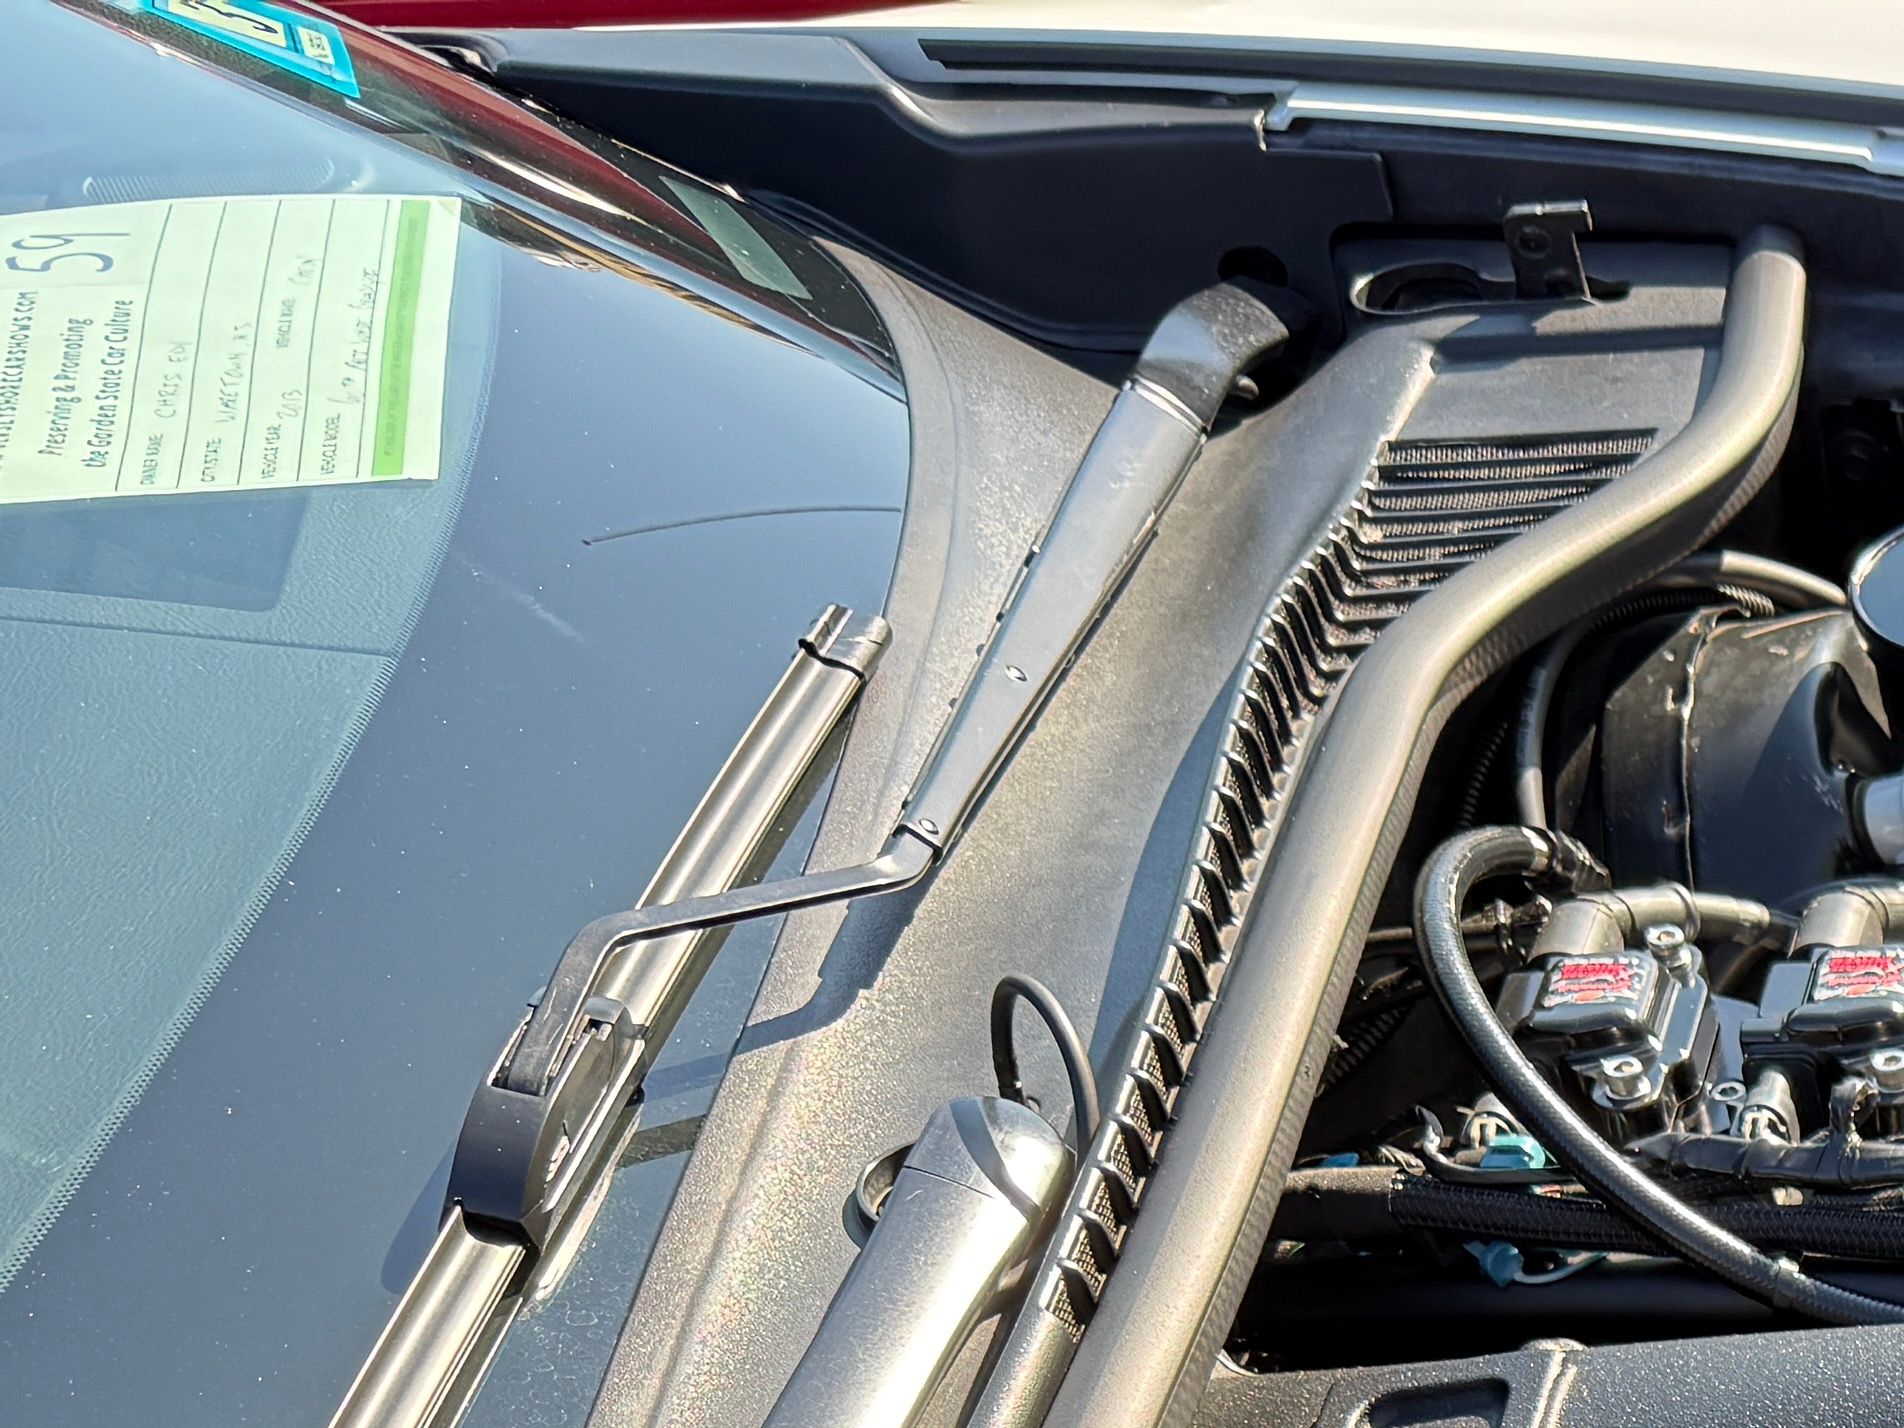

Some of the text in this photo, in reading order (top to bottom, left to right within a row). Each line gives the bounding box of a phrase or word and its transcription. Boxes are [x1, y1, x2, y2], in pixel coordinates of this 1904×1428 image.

[4, 231, 131, 273] 59
[36, 317, 93, 457] Preserving & Promoting
[80, 299, 135, 469] the Garden State Car Culture
